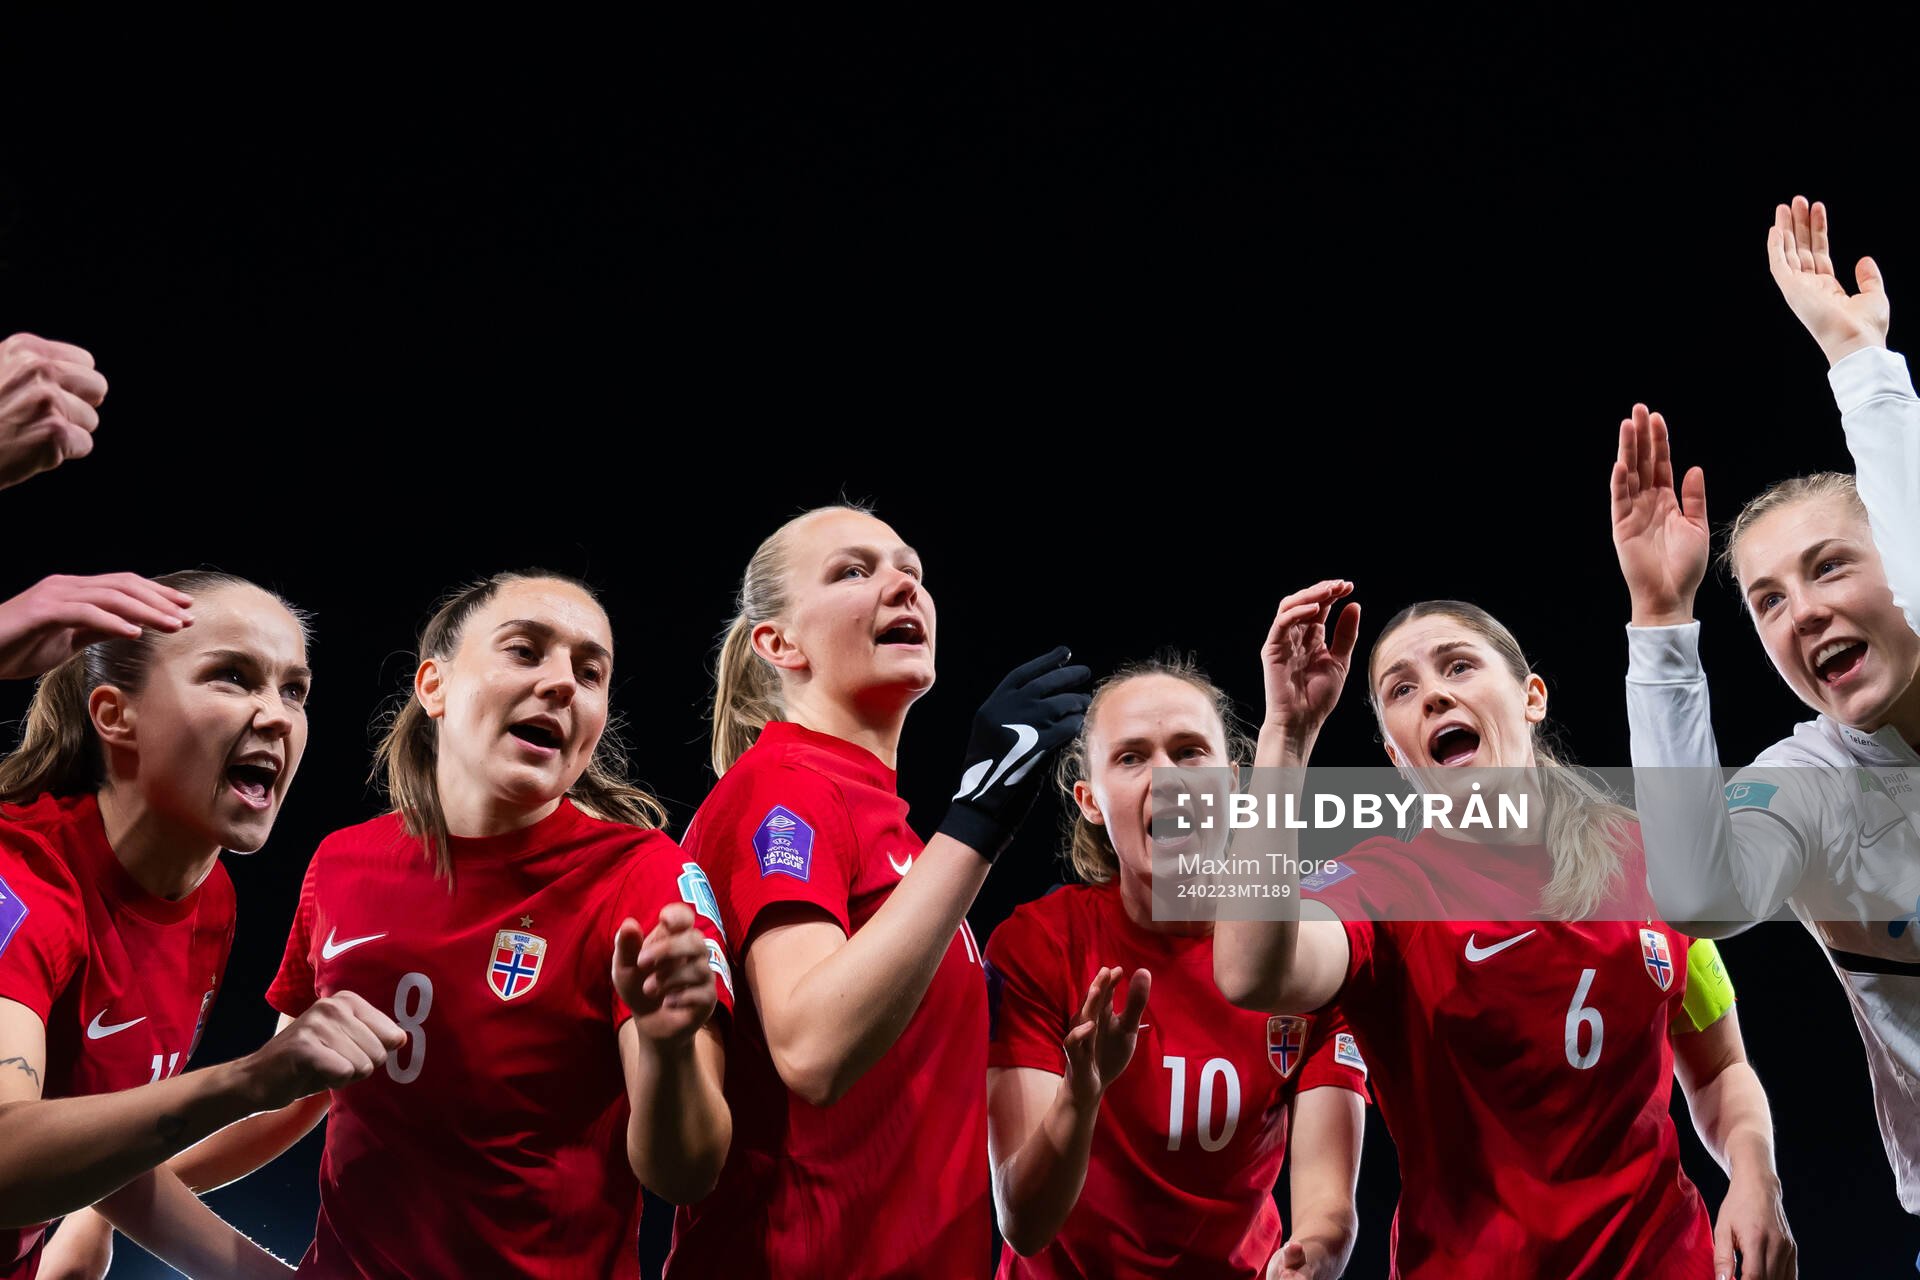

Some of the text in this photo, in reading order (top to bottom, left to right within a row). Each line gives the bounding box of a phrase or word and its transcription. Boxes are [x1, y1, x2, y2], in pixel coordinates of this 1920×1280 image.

[1882, 768, 1909, 785] mini
[766, 857, 802, 870] LEAGUE
[386, 972, 433, 1084] 8
[1565, 968, 1604, 1070] 6
[1163, 1055, 1241, 1152] 10
